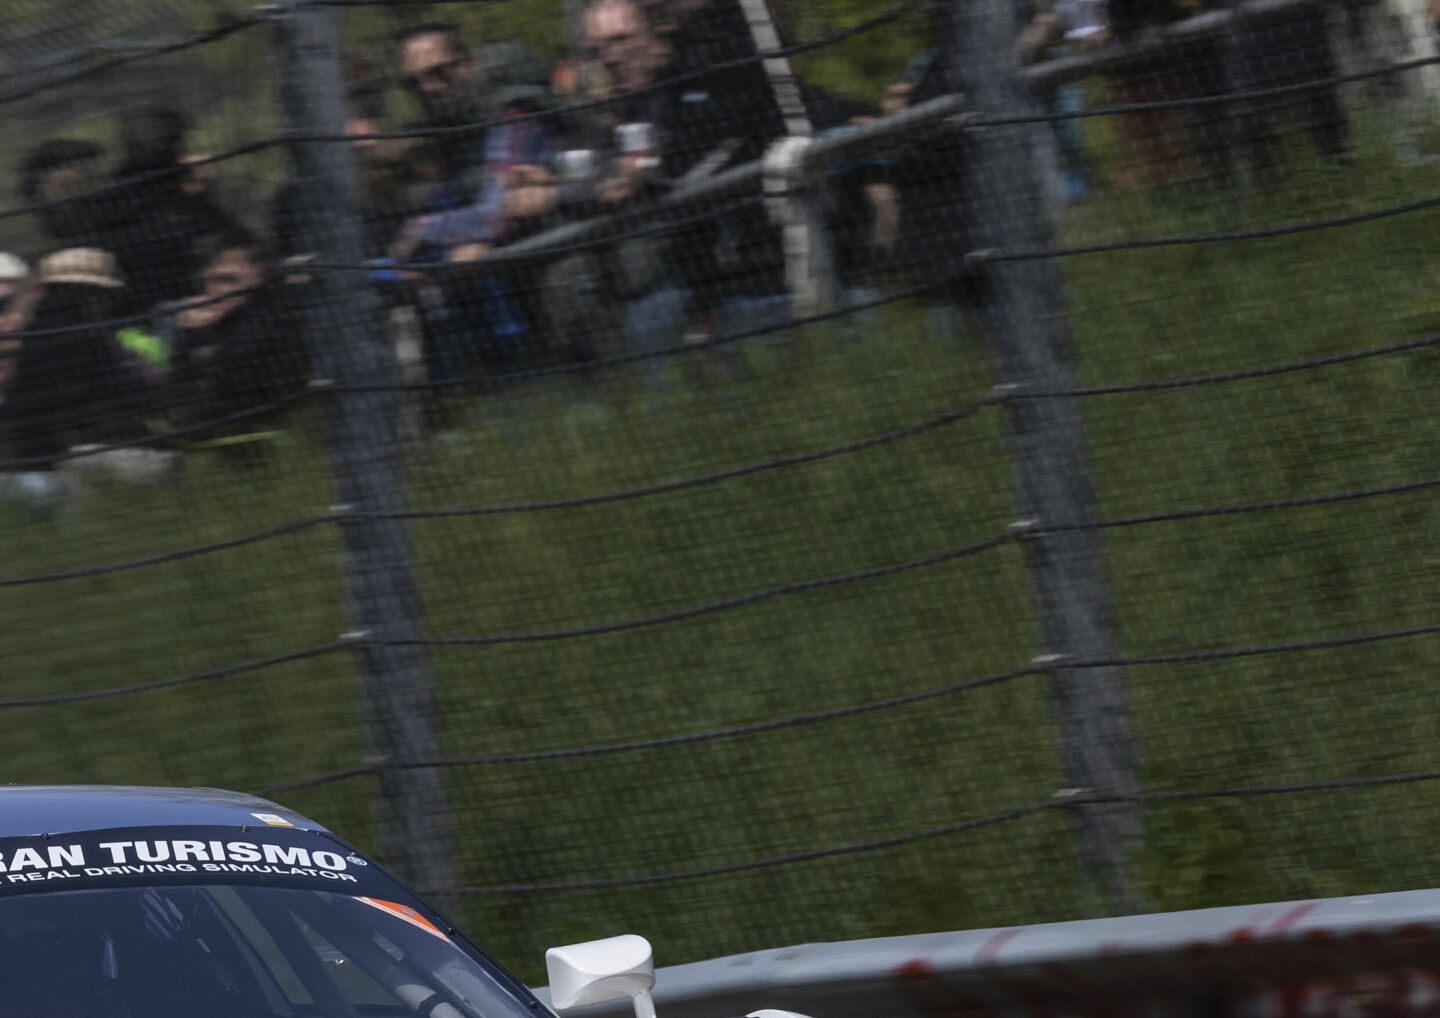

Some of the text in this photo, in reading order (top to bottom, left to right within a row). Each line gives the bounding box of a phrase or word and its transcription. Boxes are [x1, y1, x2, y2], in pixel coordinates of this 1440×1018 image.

[6, 869, 81, 884] REAL
[83, 862, 197, 878] DRIVING
[202, 863, 359, 883] SIMULATOR
